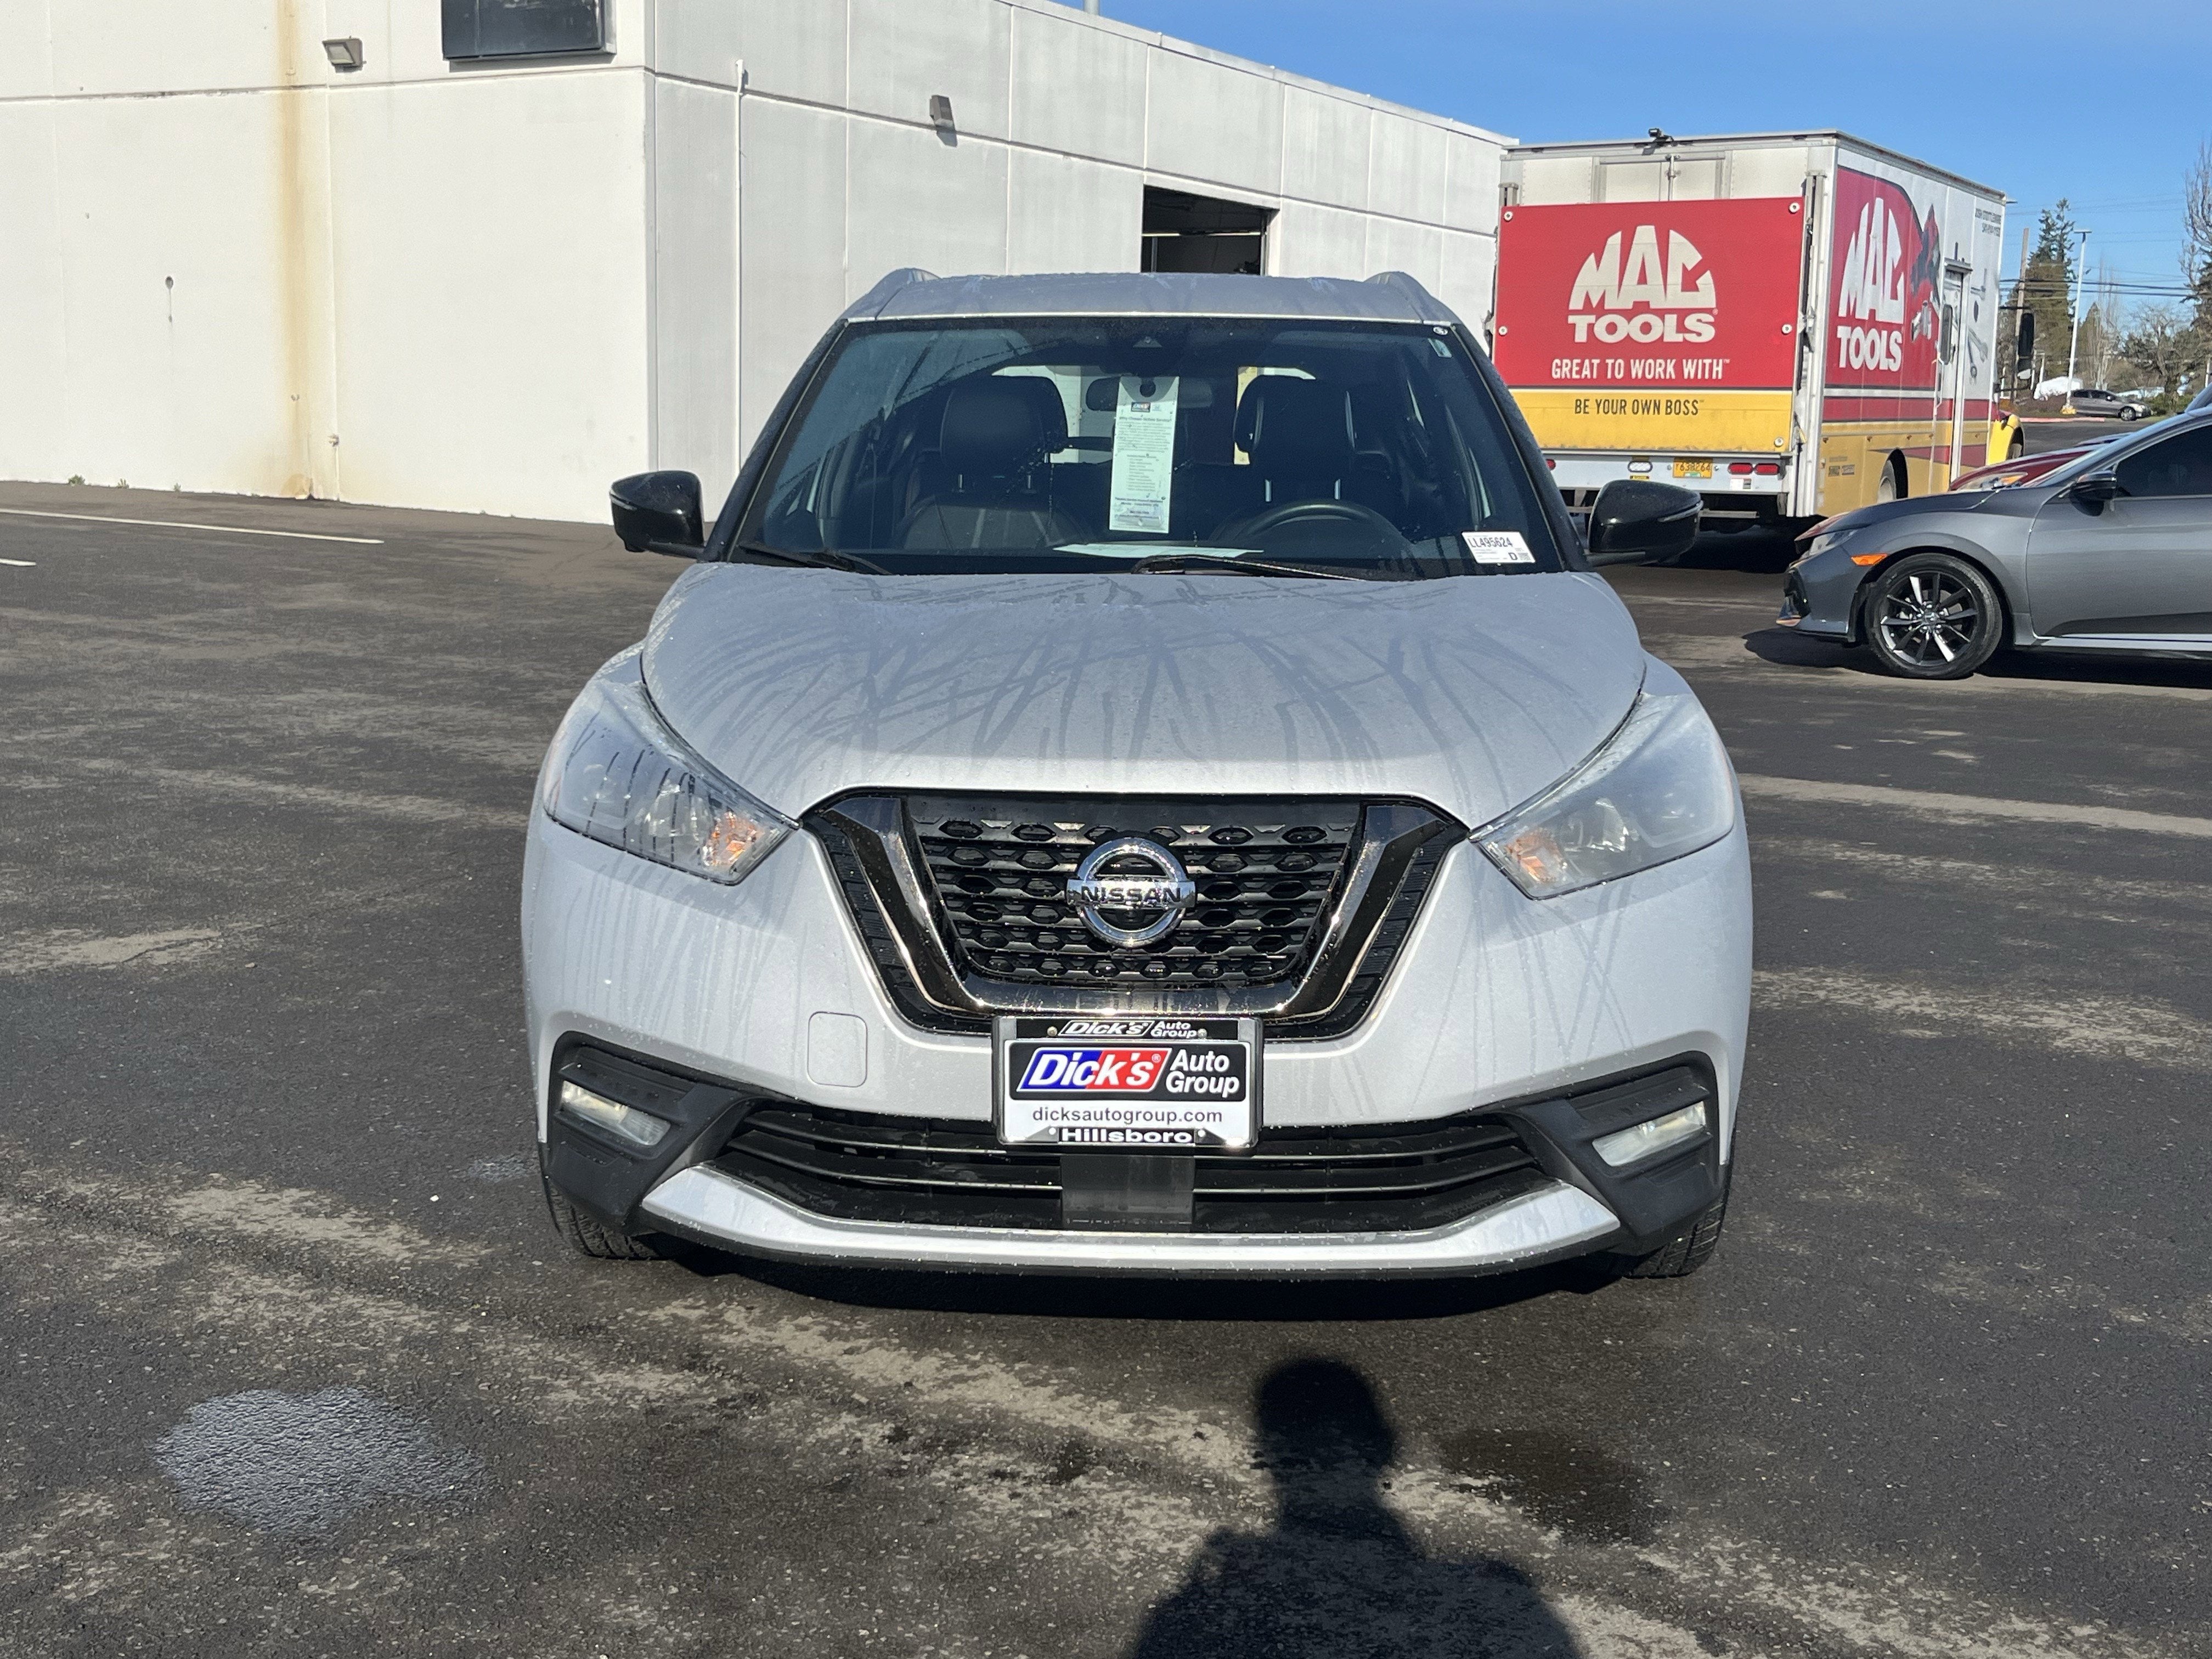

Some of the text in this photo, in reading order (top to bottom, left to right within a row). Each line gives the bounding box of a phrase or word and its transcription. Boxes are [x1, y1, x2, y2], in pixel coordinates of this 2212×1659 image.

[1568, 224, 1717, 310] MAC
[1838, 197, 1905, 324] MAC
[1567, 313, 1716, 343] TOOLS
[1837, 325, 1903, 372] TOOLS
[1551, 358, 1600, 379] GREAT
[1605, 359, 1625, 379] TO
[1630, 359, 1676, 380] WORK
[1575, 399, 1699, 415] BE YOUR OWN BOSS
[1467, 537, 1513, 548] LL495624
[1080, 885, 1181, 903] NISSAN
[1065, 1021, 1144, 1035] Dick's
[1150, 1028, 1197, 1038] Group
[1154, 1020, 1191, 1030] Auto
[1028, 1052, 1154, 1086] Dick's
[1170, 1049, 1230, 1072] Auto
[1166, 1070, 1240, 1098] Group
[1032, 1107, 1222, 1125] dicksautogroup.com
[1060, 1128, 1193, 1143] Hillsboro
